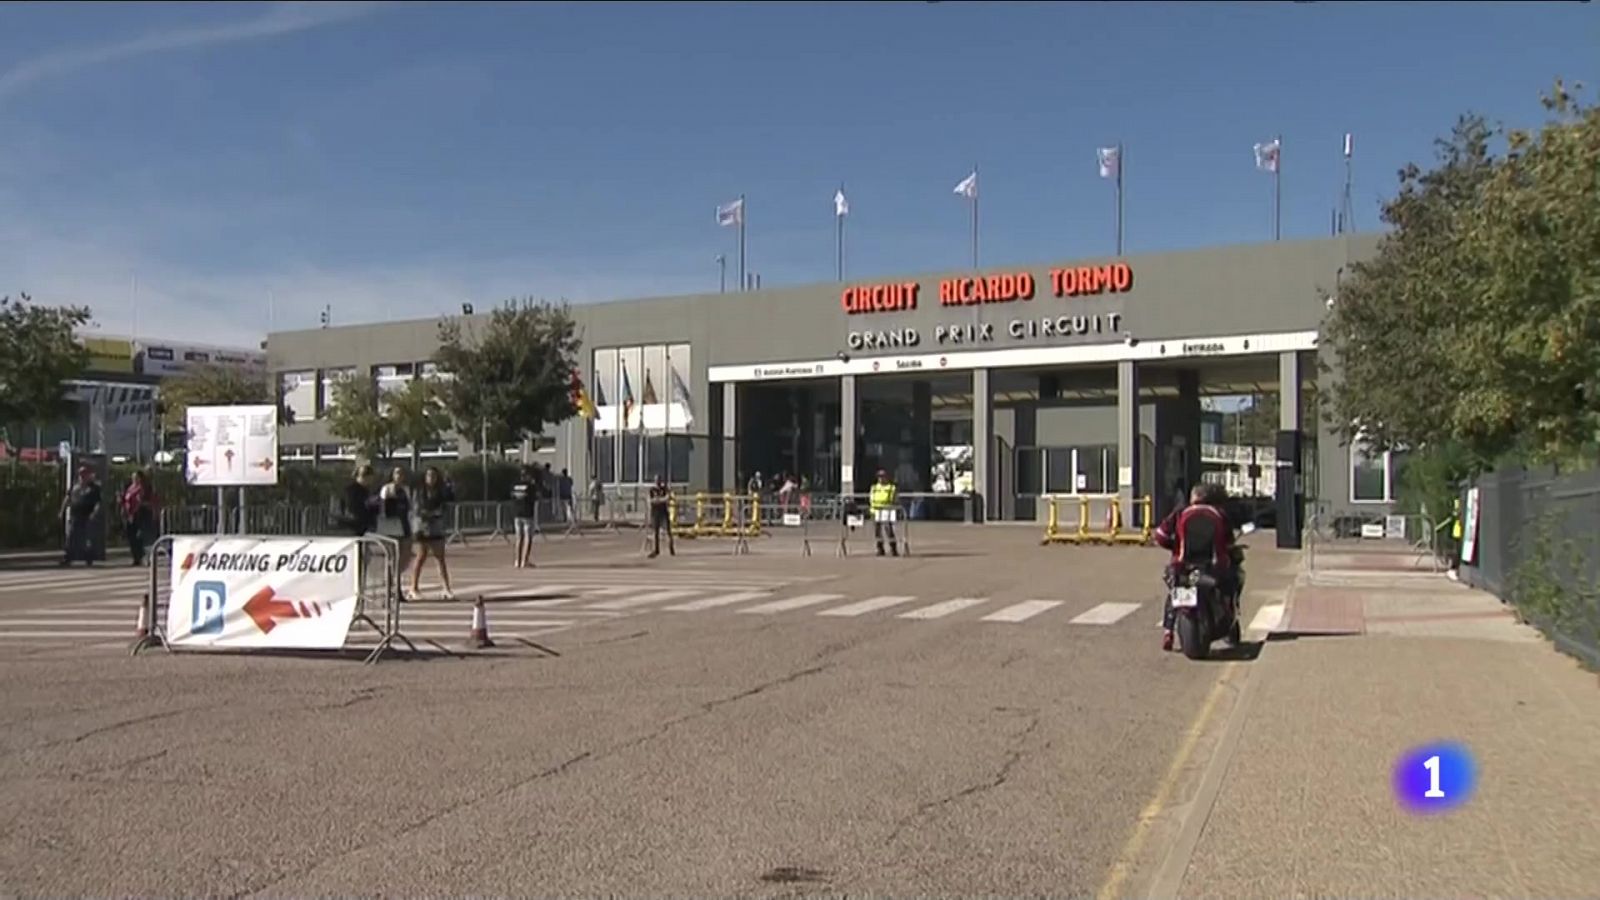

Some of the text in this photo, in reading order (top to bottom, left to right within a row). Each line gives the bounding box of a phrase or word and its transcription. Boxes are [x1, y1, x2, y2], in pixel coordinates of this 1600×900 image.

[841, 263, 1133, 313] CIRCUIT RICARDO TORMO
[848, 312, 1121, 350] GRAND PRIX CIRCUIT
[197, 551, 348, 573] PARKING PÚBLICO
[195, 588, 222, 630] P
